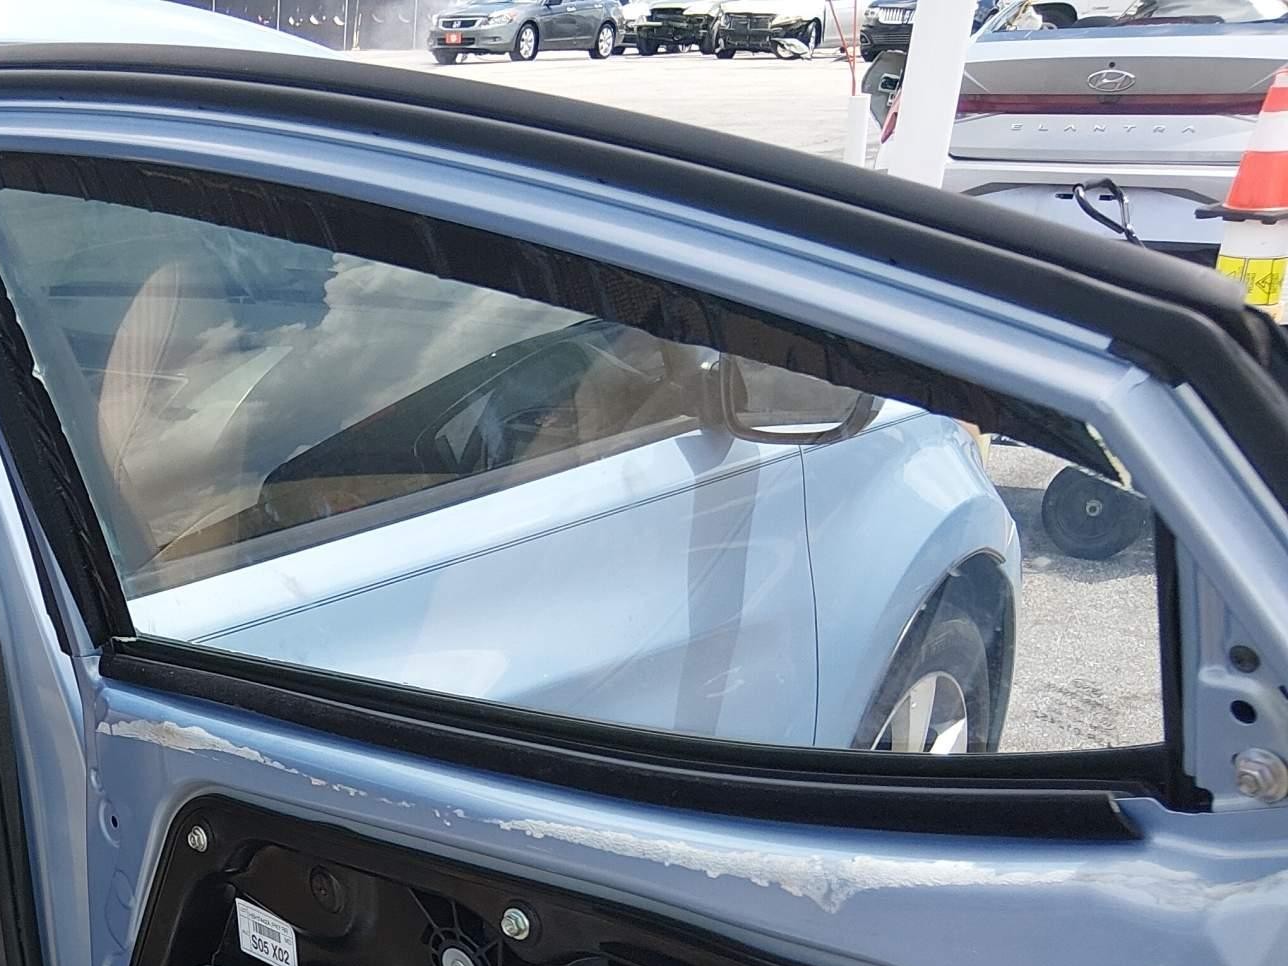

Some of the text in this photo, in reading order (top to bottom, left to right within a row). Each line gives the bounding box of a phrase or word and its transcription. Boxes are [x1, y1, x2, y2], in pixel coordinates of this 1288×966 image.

[1010, 123, 1196, 134] ELANTRA
[251, 934, 270, 955] S05
[272, 944, 290, 966] X02
